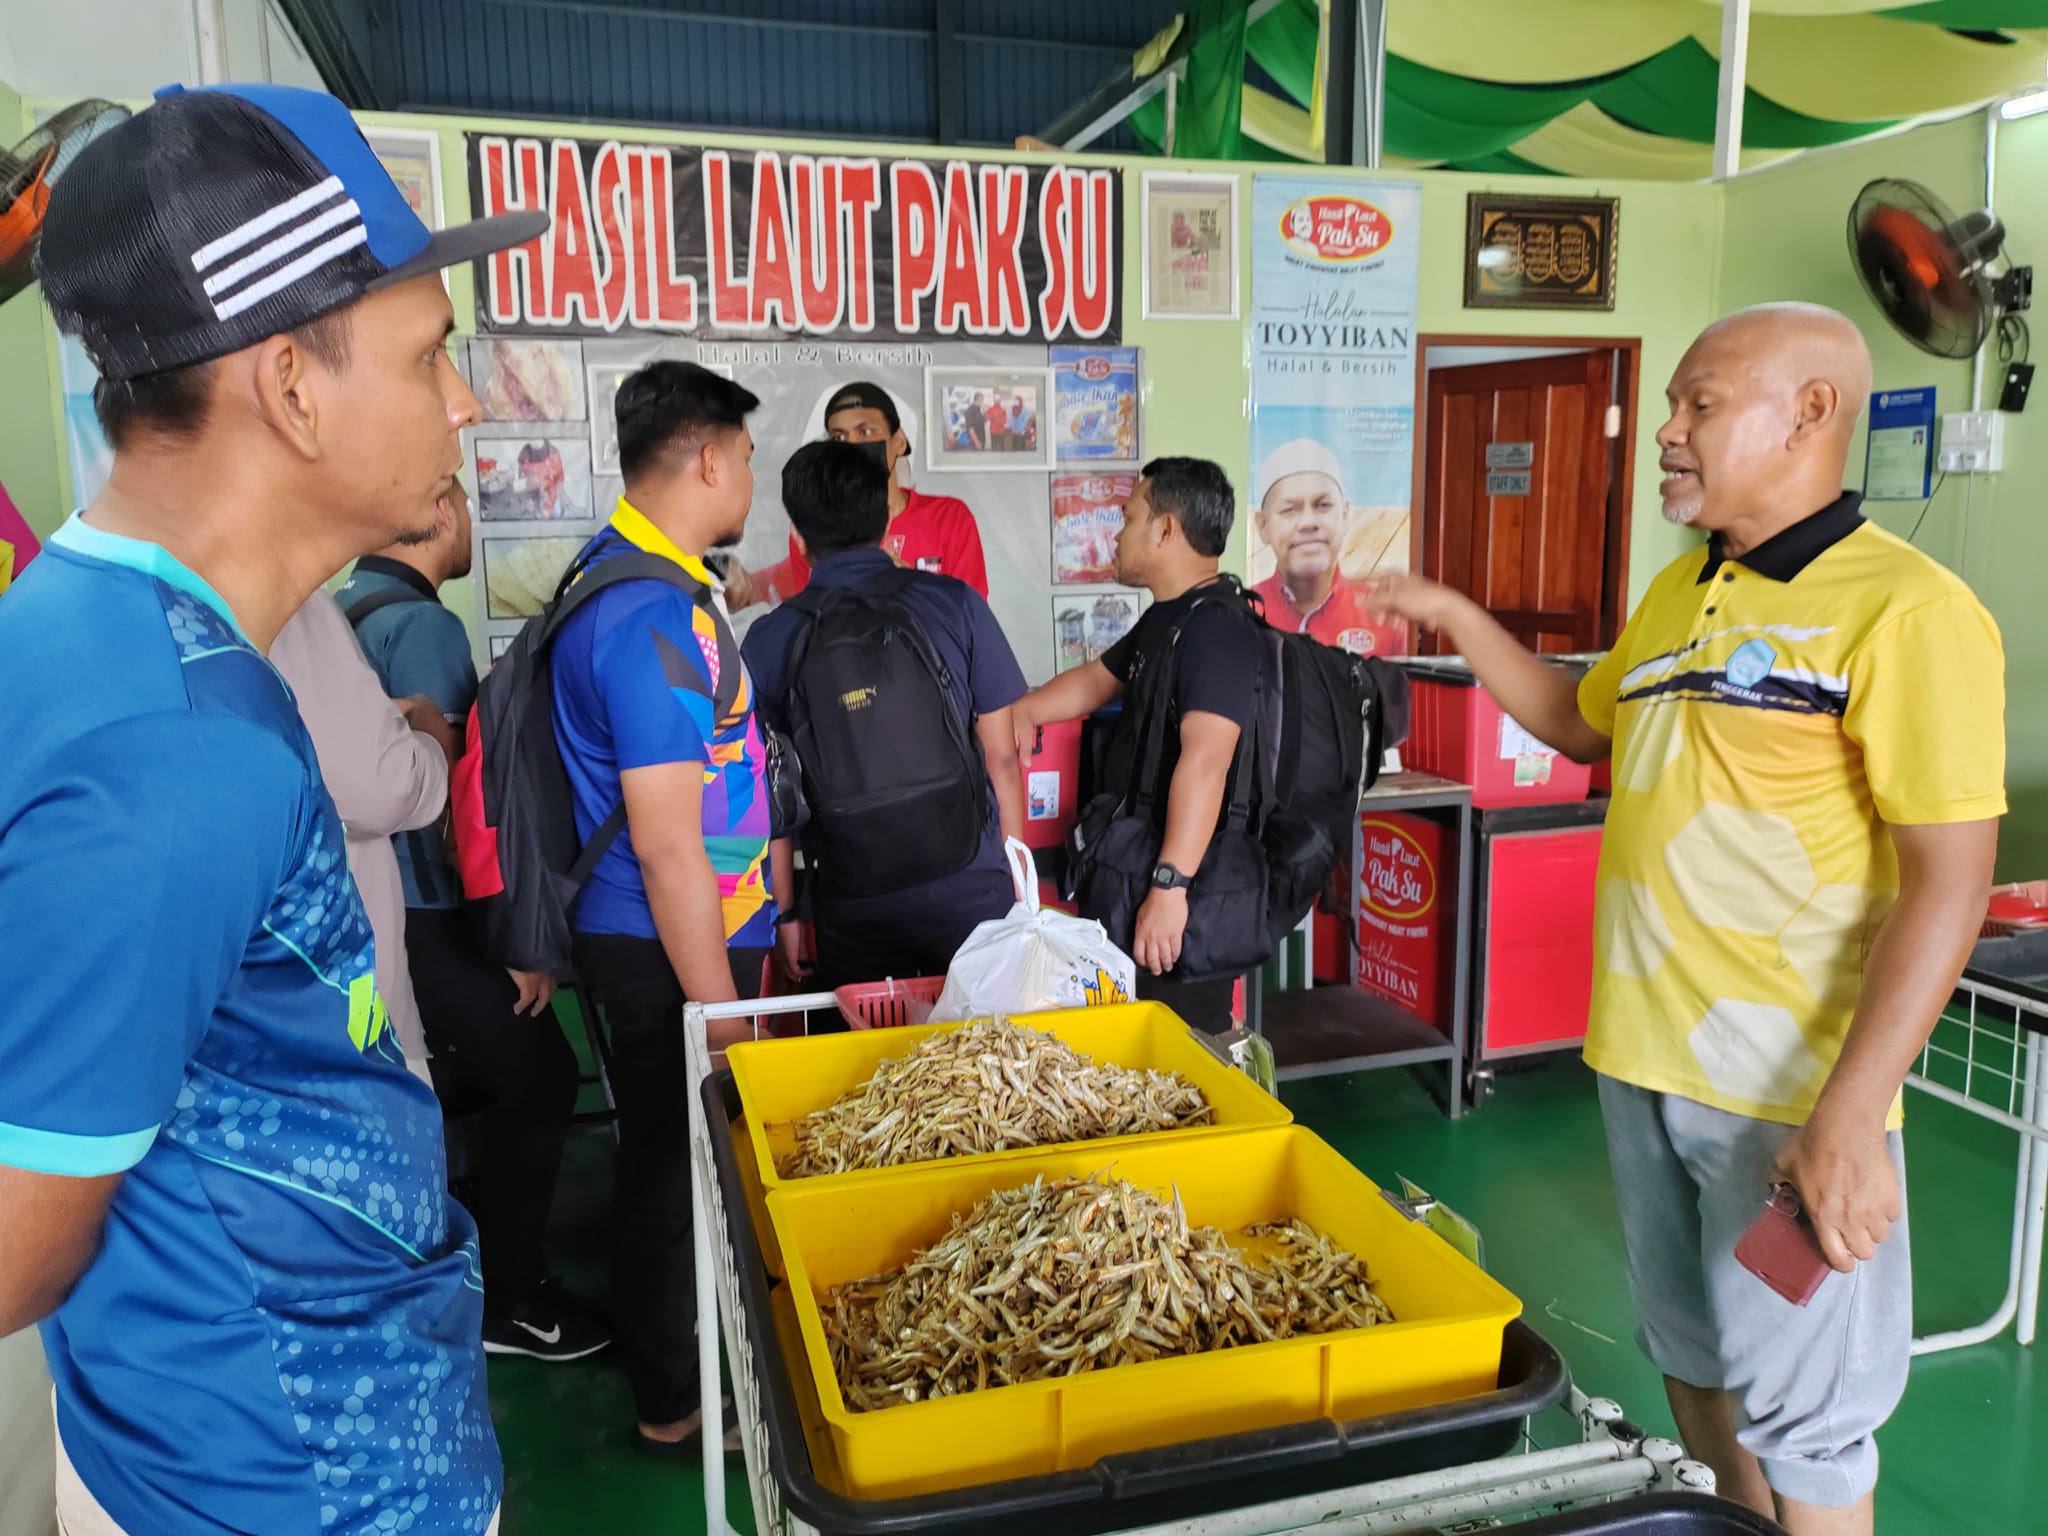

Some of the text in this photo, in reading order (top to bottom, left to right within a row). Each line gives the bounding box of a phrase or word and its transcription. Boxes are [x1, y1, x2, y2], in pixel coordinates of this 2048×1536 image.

[479, 137, 1112, 340] HASIL LAUT PAK SU
[1317, 221, 1379, 248] Pak Su
[1258, 321, 1408, 349] TOYYIBAN
[698, 343, 933, 366] Halal & Bersih
[1267, 358, 1396, 375] Halal & Bersih
[1369, 835, 1421, 868] Hasil Laut
[1369, 857, 1422, 904] Pak Su
